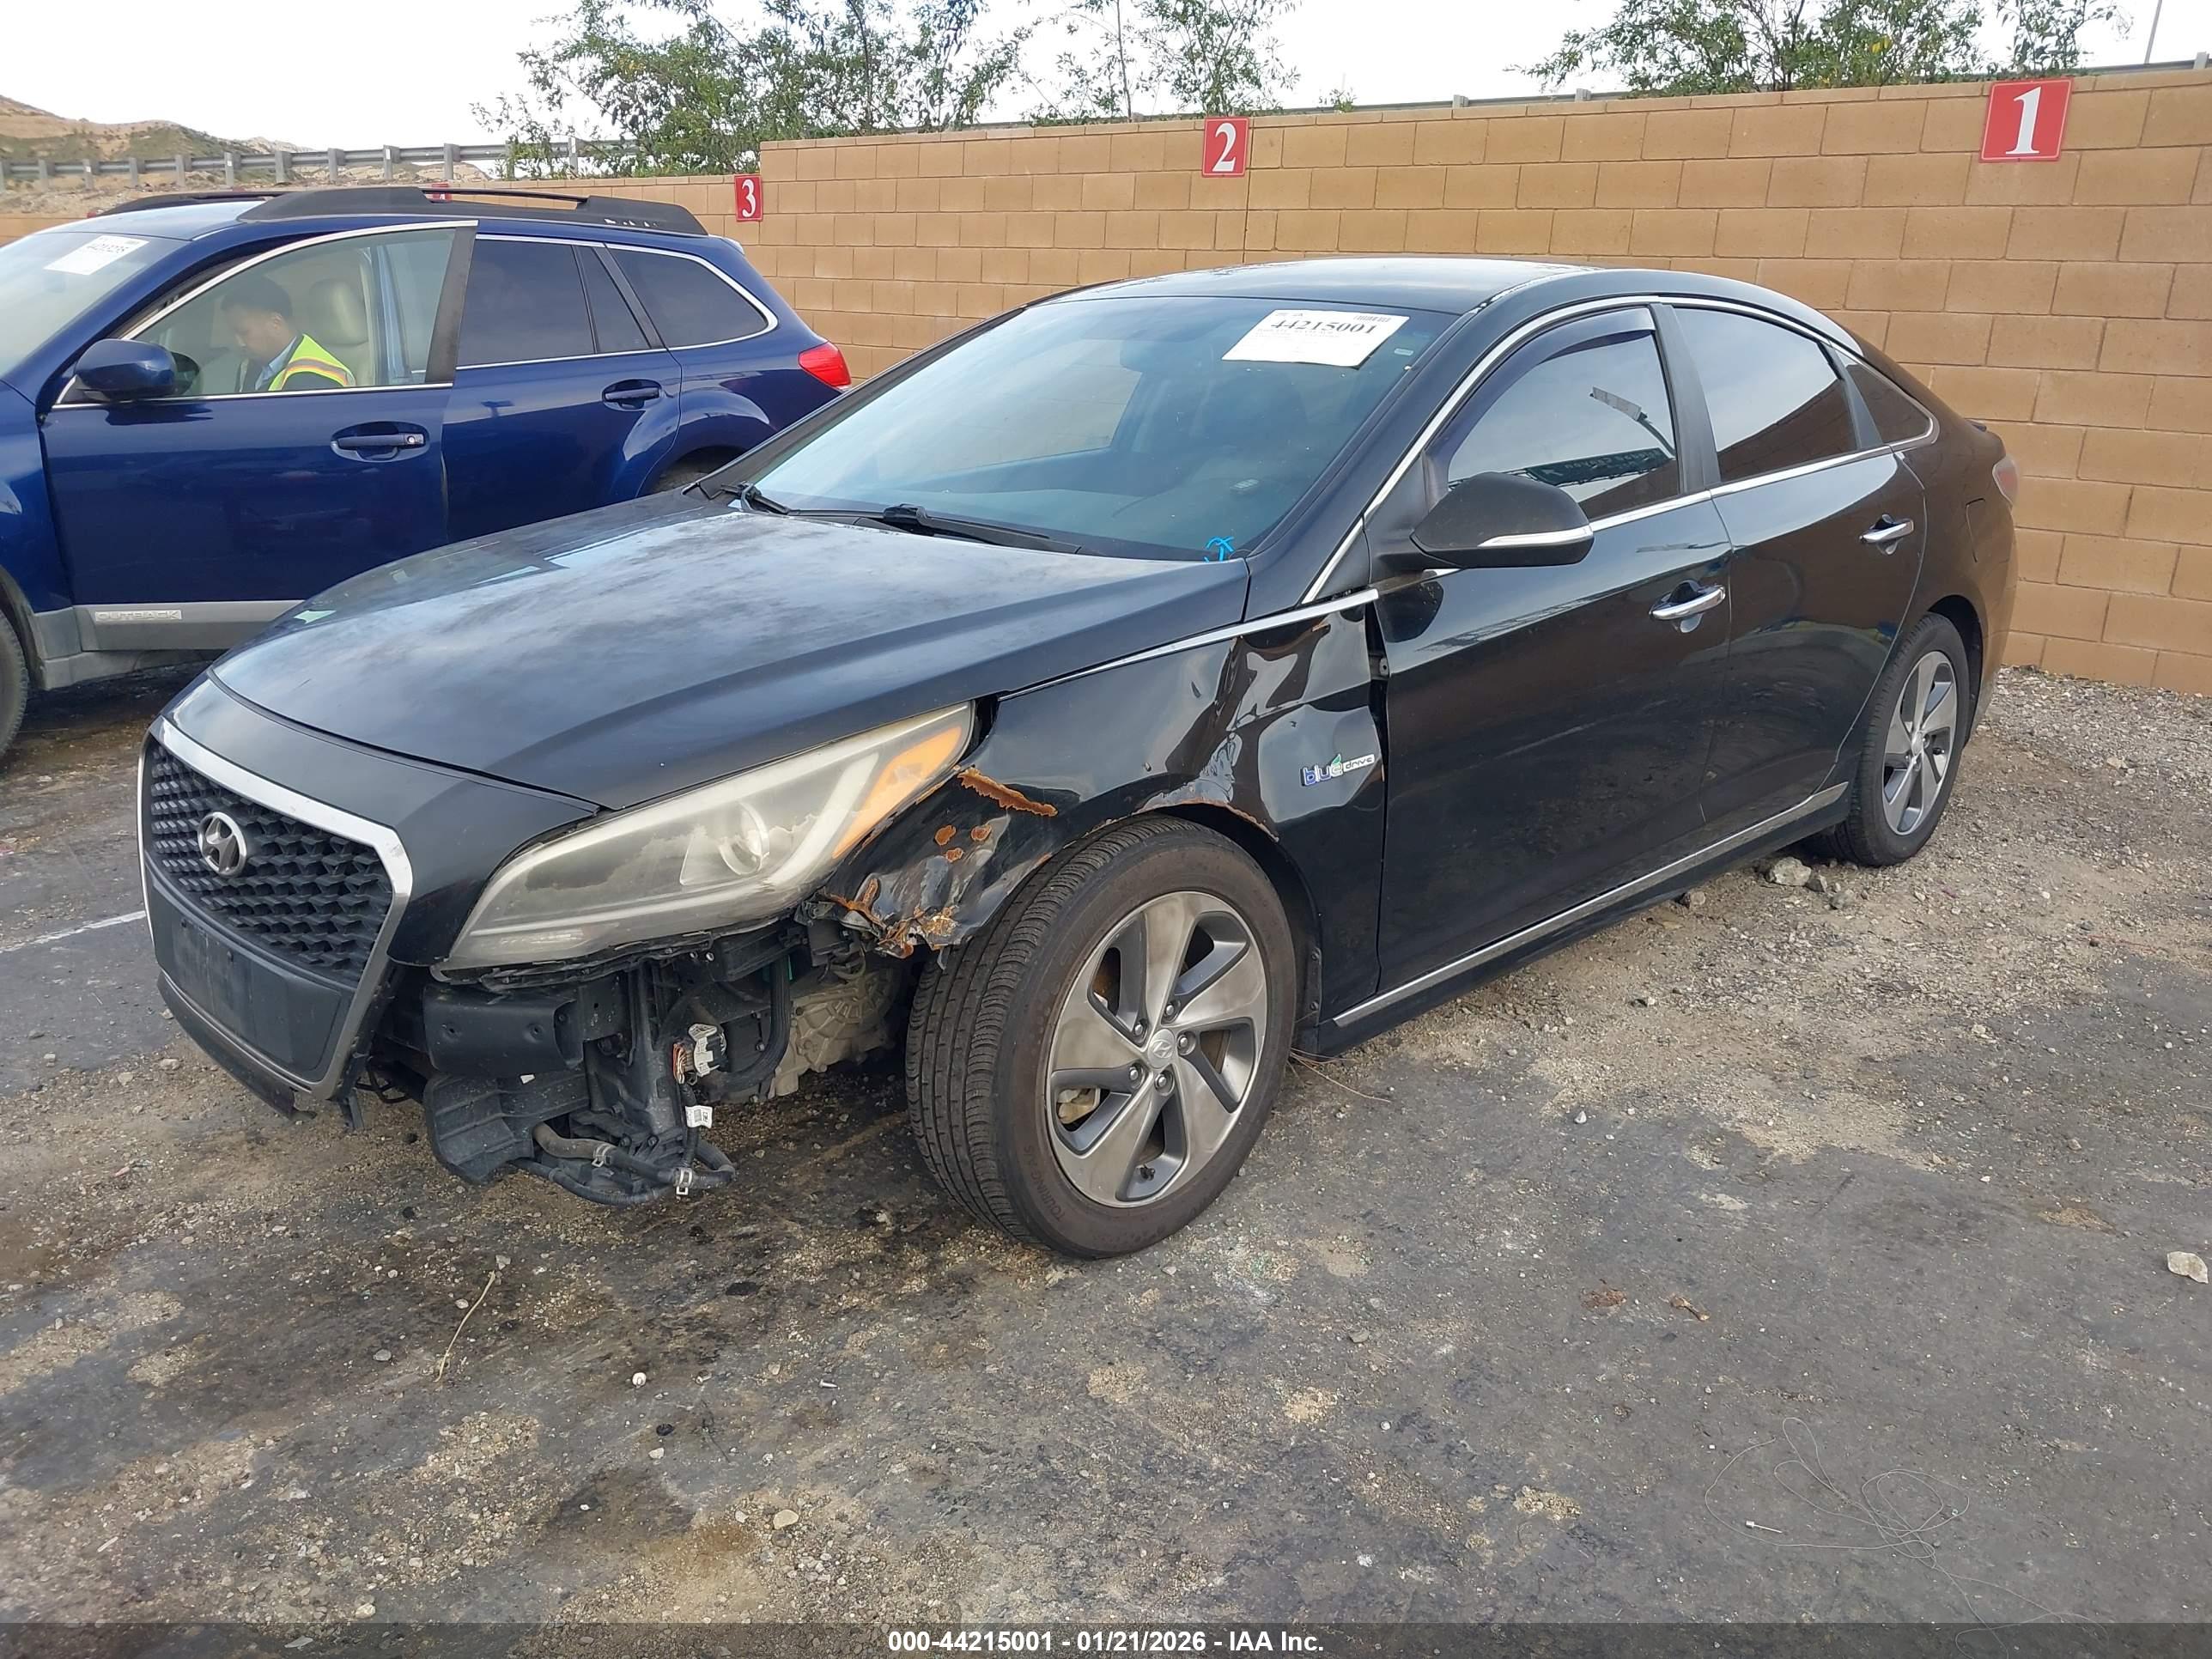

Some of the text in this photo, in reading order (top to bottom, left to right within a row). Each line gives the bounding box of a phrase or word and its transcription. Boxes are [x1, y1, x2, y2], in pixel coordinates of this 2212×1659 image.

[2005, 86, 2042, 155] 1
[1212, 122, 1237, 172] 2
[741, 179, 756, 217] 3
[1270, 319, 1376, 335] 44215001
[97, 611, 180, 620] OUTBACK
[1302, 754, 1373, 786] blue drive
[1030, 1170, 1066, 1220] TOURING
